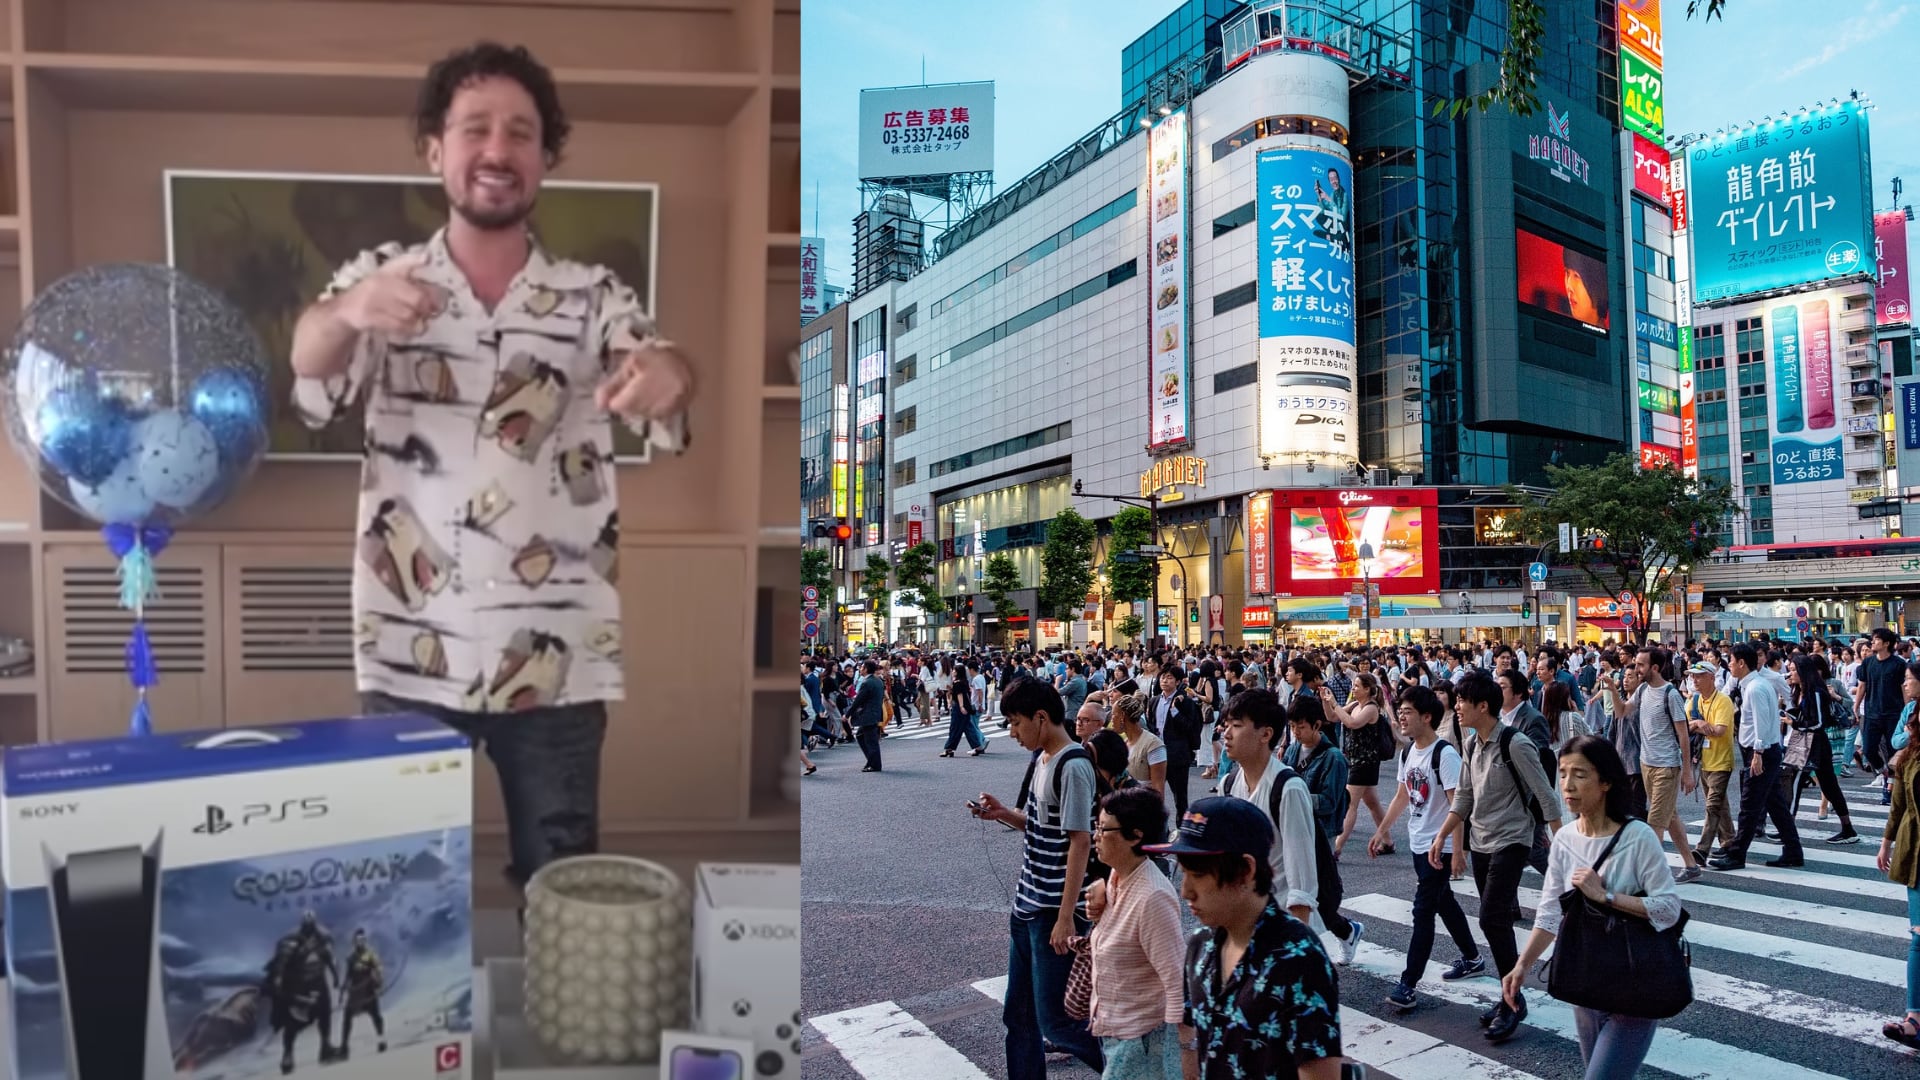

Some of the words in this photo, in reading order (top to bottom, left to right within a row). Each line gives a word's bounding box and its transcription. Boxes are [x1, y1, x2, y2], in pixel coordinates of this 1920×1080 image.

[1626, 12, 1664, 57] アコム
[1624, 58, 1661, 100] レイク
[883, 107, 970, 128] 広告募集
[1624, 88, 1663, 128] ALSA
[883, 125, 970, 144] 03-5337-2468
[1694, 111, 1850, 161] のど、直接、うるおう
[890, 142, 961, 155] 株式会社タップ
[1261, 154, 1292, 163] Panasonic
[1529, 134, 1590, 186] MAGNET
[1634, 150, 1670, 184] アイフル
[1727, 147, 1816, 204] 龍角散
[1270, 185, 1302, 199] その
[1676, 200, 1685, 229] アイフル
[1716, 191, 1836, 246] ダイレクト
[1271, 233, 1350, 264] ディーガが
[1727, 245, 1777, 264] スティック
[1827, 249, 1857, 267] 生薬
[802, 243, 818, 300] 大和証券
[1271, 257, 1351, 299] 軽くして
[1887, 304, 1907, 315] 生薬
[1636, 318, 1674, 343] レオパレス21
[1280, 346, 1350, 361] スマホの写真や動画は
[1638, 386, 1658, 402] レイク
[1295, 414, 1344, 426] DIGA
[1683, 419, 1694, 446] アコム
[1776, 447, 1842, 464] のど、直接、
[1141, 456, 1207, 498] MAGNET
[1783, 465, 1832, 480] うるおう
[1339, 491, 1374, 505] Glico
[1254, 512, 1266, 590] 天津甘栗
[1901, 559, 1919, 570] JR
[20, 803, 79, 819] SONY
[243, 795, 329, 826] PS5
[233, 869, 307, 904] GOD
[749, 924, 797, 940] XBOX
